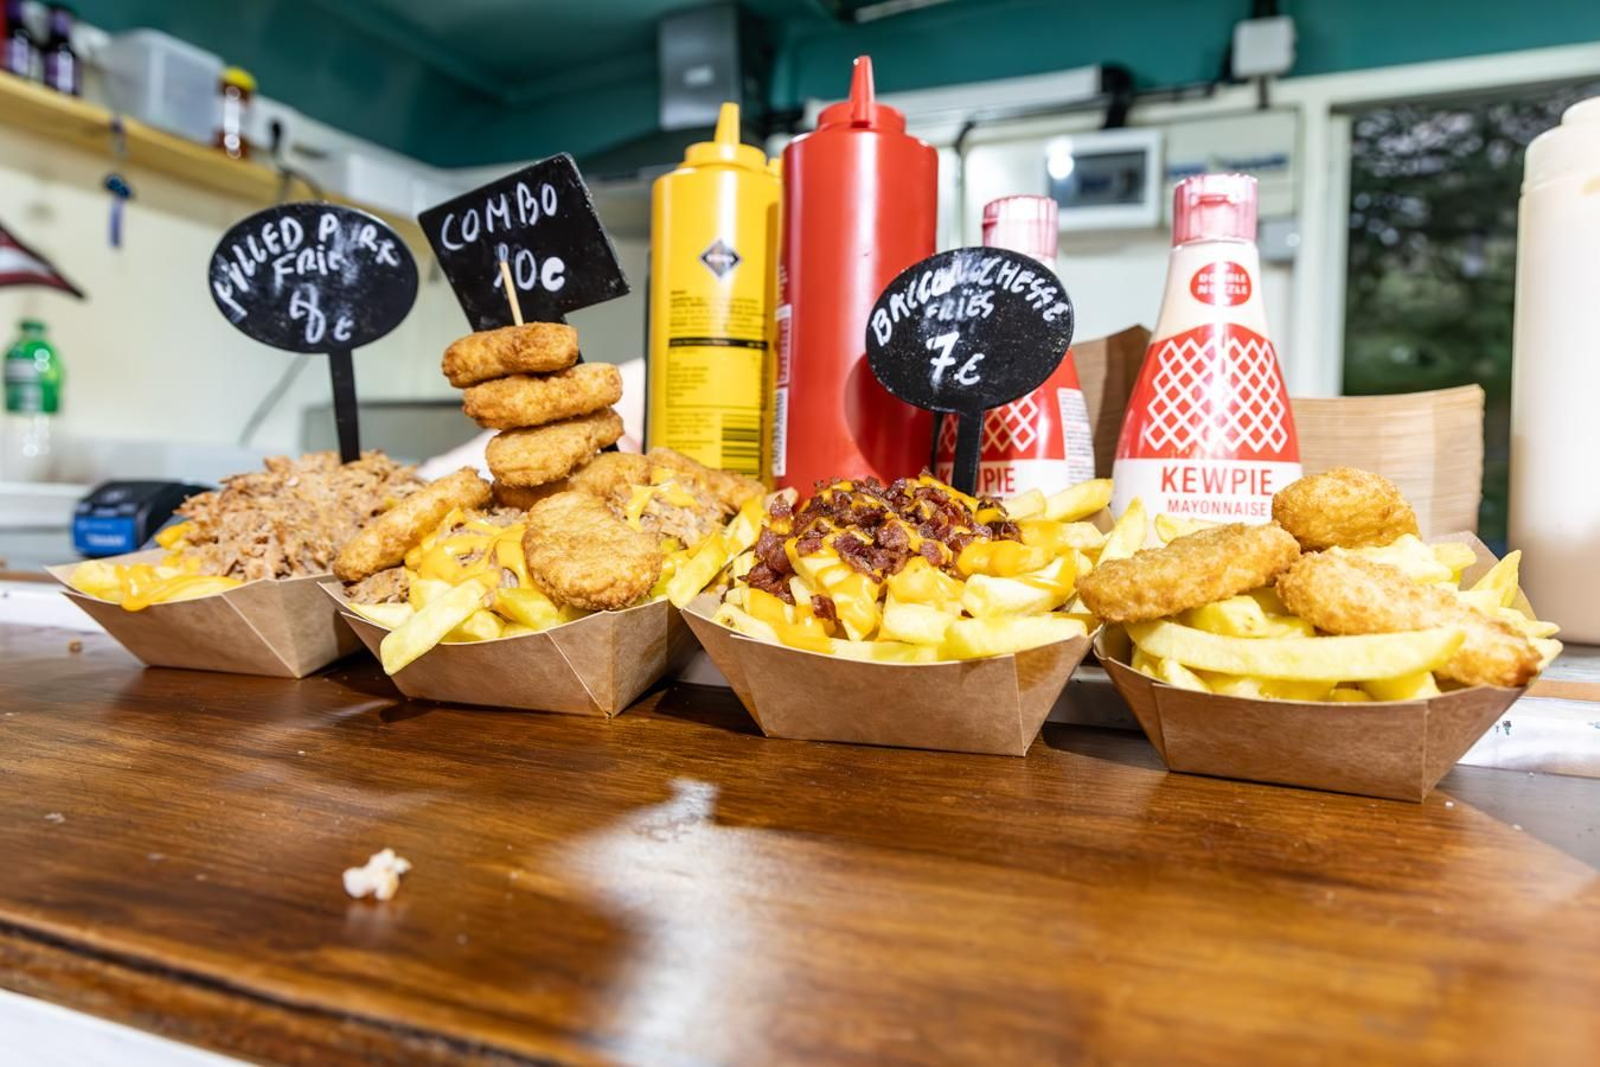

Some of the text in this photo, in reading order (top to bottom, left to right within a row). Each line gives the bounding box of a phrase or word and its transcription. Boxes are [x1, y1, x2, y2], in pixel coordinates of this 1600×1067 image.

[440, 182, 558, 250] COMBO
[938, 466, 1015, 493] KPIE
[1161, 466, 1273, 496] KEWPIE
[1167, 499, 1268, 517] MAYONNAISE
